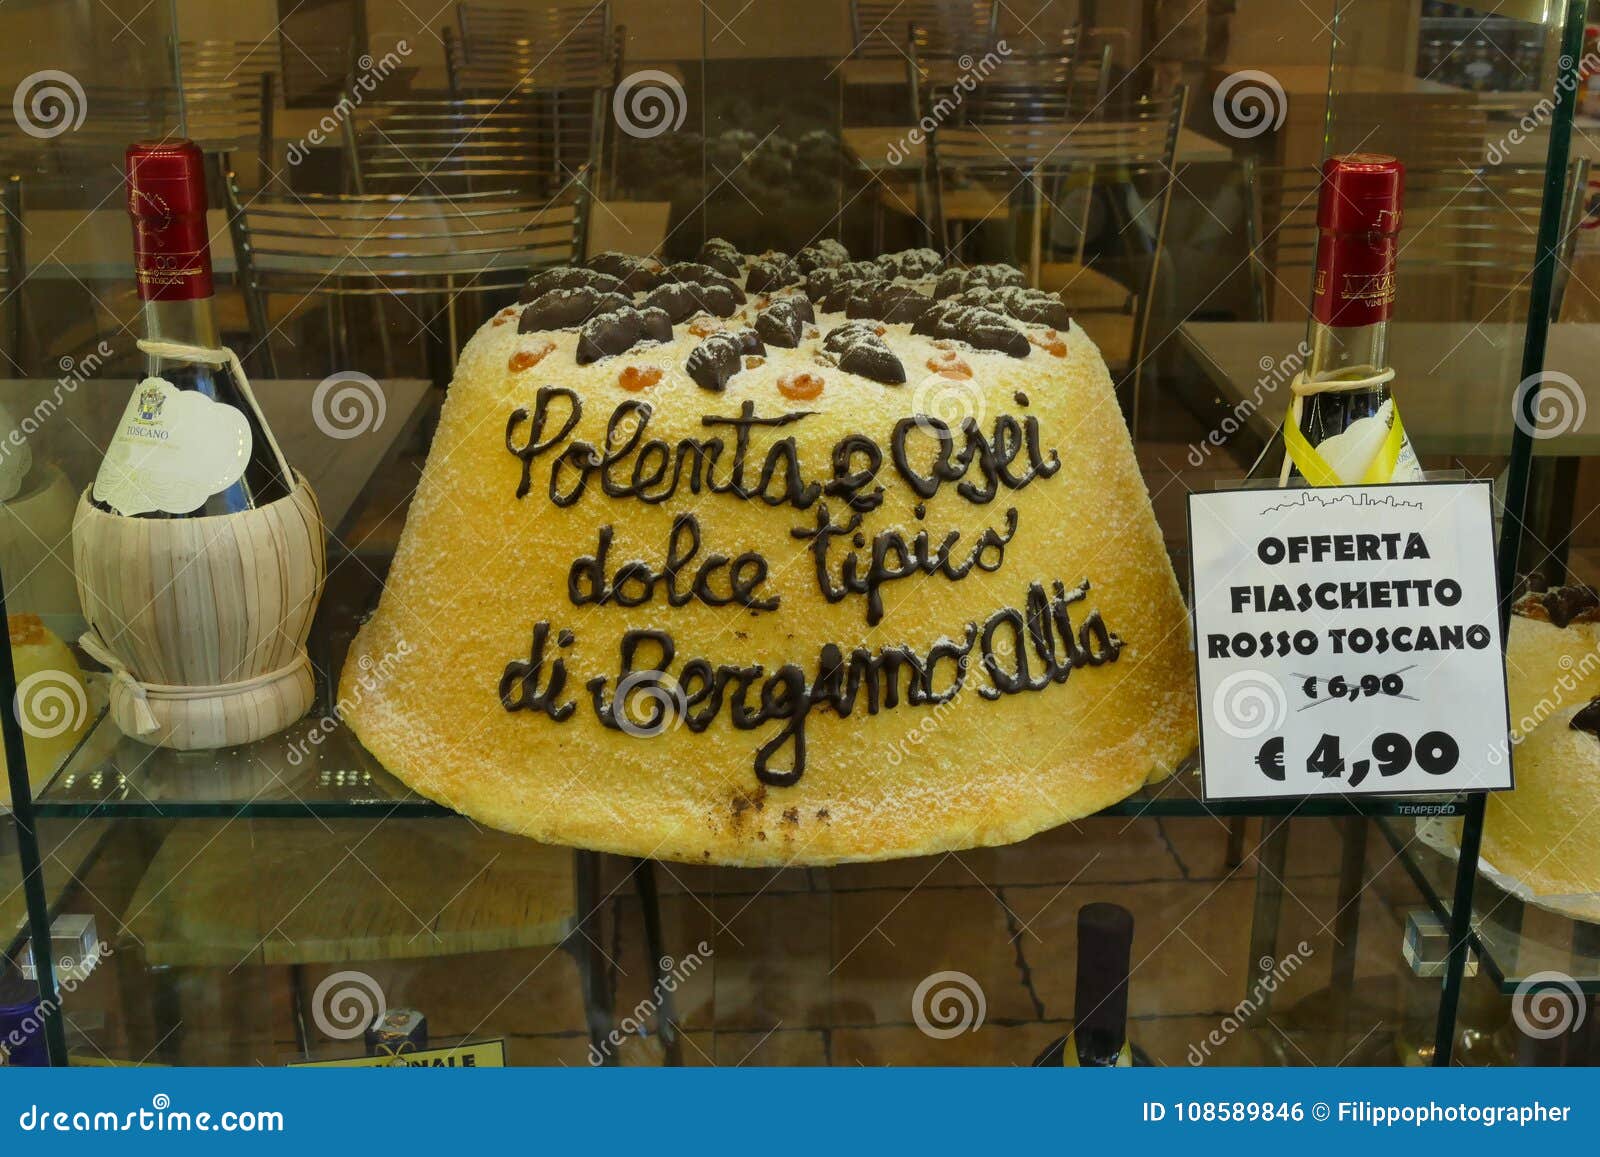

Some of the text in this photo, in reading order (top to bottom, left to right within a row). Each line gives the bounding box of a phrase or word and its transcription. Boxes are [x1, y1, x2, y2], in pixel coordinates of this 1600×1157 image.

[506, 385, 821, 508] Polenta
[568, 502, 1018, 627] dolce tipico
[1257, 532, 1430, 565] OFFERTA
[1230, 578, 1462, 613] FIASCHETTO
[1207, 624, 1491, 659] ROSSO TOSCANO
[499, 620, 576, 722] di
[586, 628, 977, 787] Bergamo
[1327, 673, 1404, 702] 6,90
[1255, 730, 1460, 788] € 4,90
[1398, 805, 1455, 815] TEMPERED
